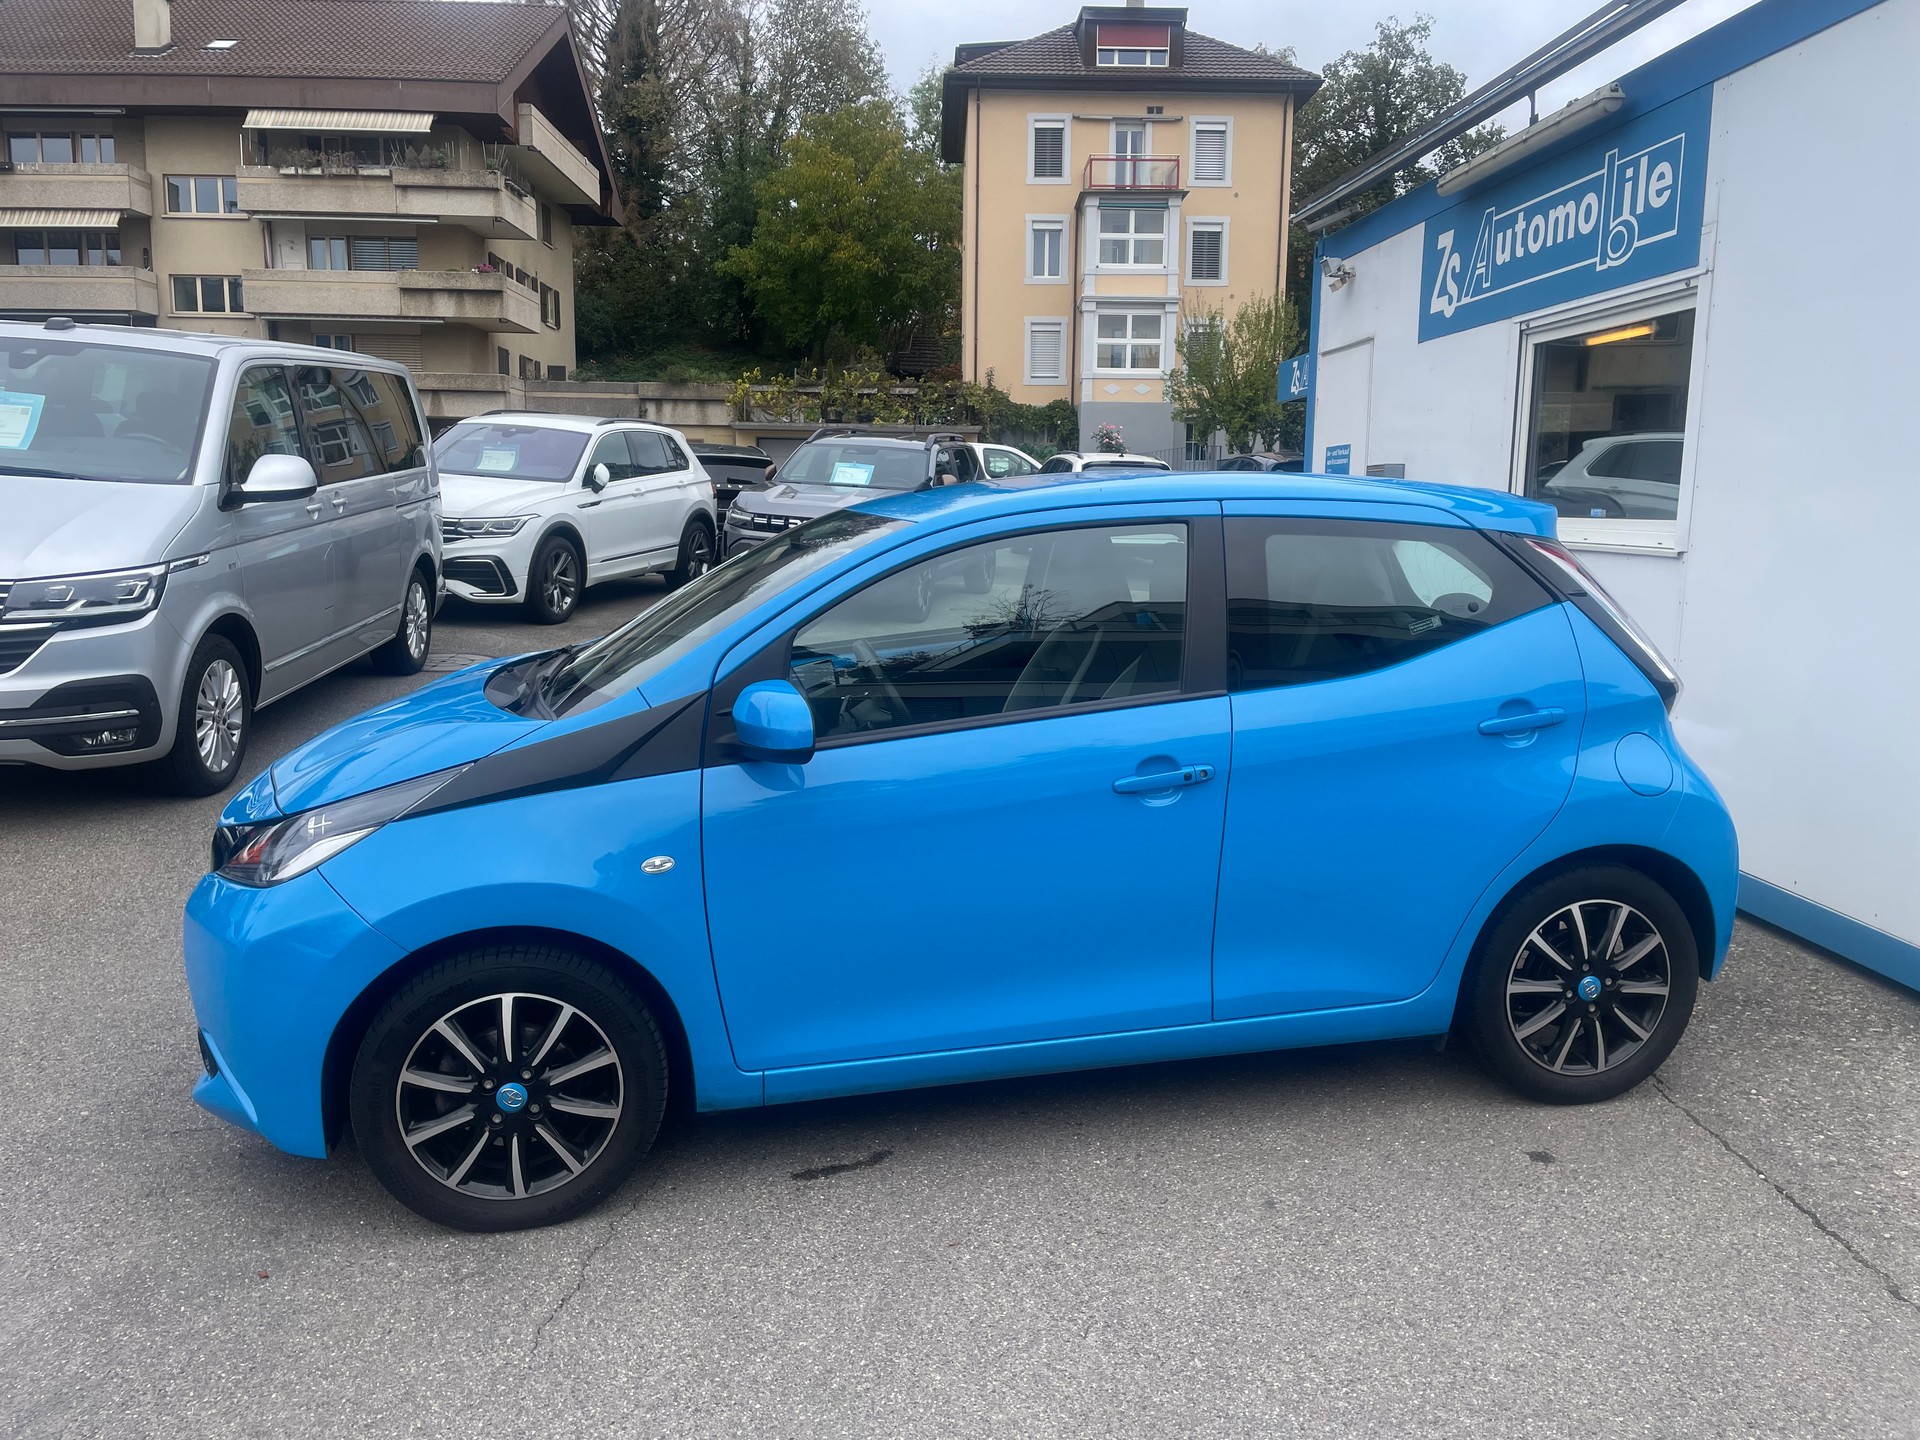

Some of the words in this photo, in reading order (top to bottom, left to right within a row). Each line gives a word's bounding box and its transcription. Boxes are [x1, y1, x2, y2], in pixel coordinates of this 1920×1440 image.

[1430, 229, 1460, 318] Zs
[1462, 149, 1673, 301] Automobile
[1290, 360, 1300, 395] Zs
